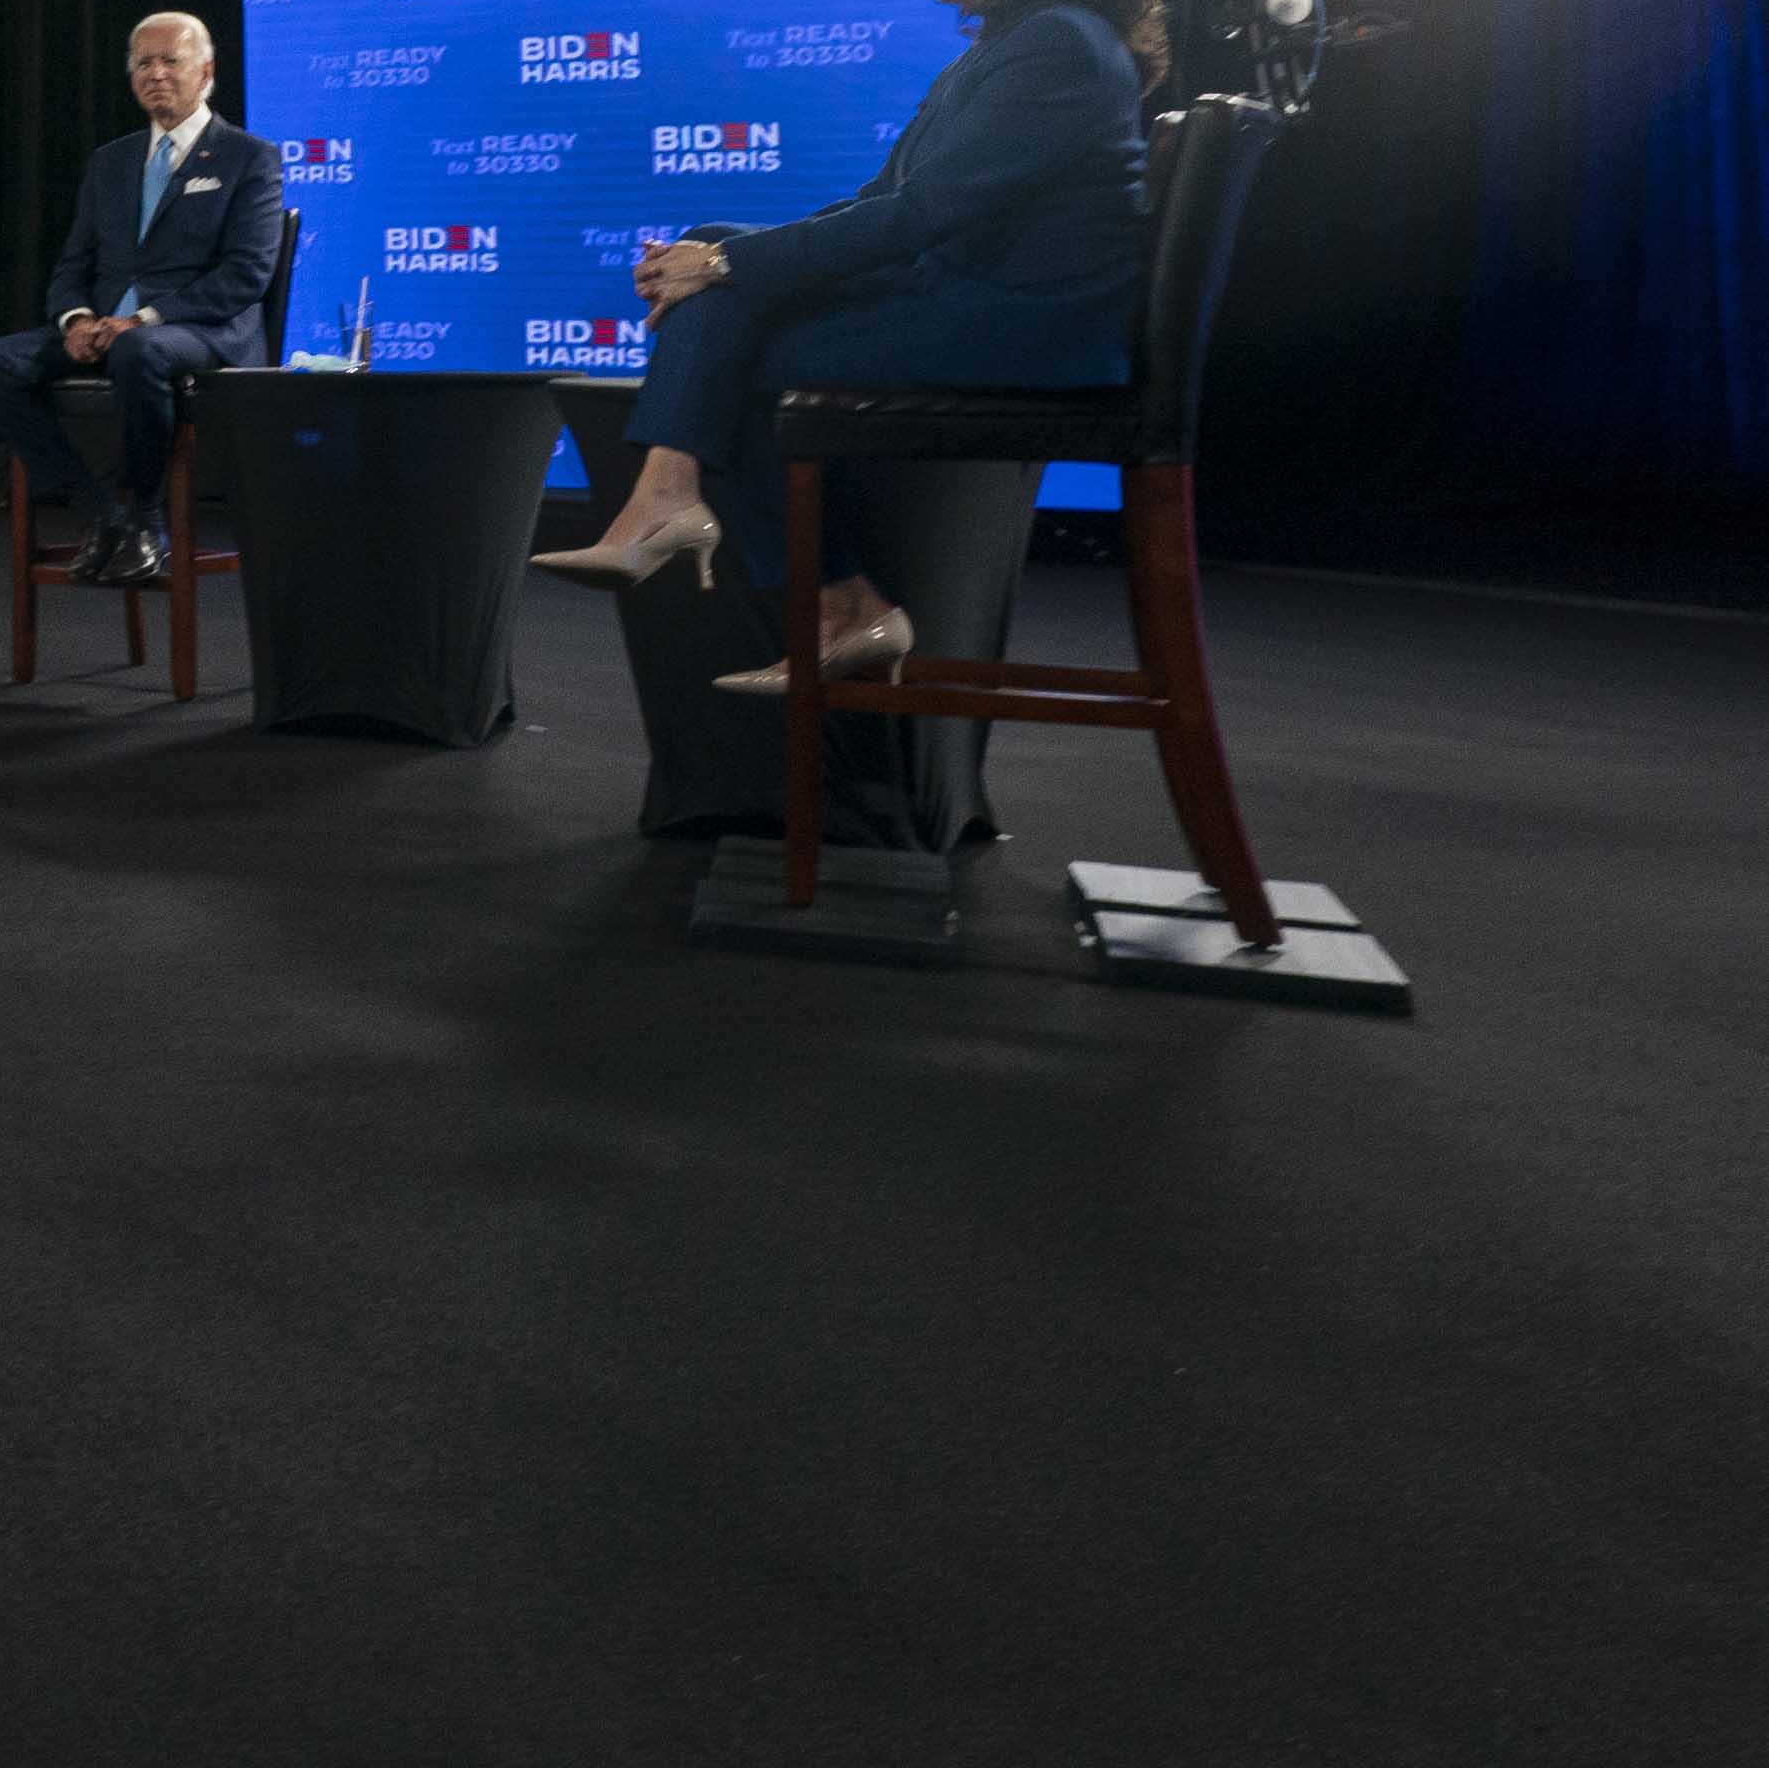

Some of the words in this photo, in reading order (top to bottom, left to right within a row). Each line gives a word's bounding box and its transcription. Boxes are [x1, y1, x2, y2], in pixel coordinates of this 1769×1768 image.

[783, 20, 895, 46] READY
[355, 45, 448, 67] READY
[520, 31, 640, 63] BIDEN
[776, 43, 874, 68] 30330
[348, 66, 431, 88] 30330
[520, 58, 642, 85] HARRIS
[481, 133, 578, 153] READY
[653, 121, 781, 153] BIDEN
[282, 138, 352, 163] DEN
[282, 164, 354, 184] RRIS
[474, 154, 561, 174] 30330
[653, 149, 783, 176] HARRIS
[385, 225, 498, 252] BIDEN
[384, 252, 499, 274] HARRIS
[378, 322, 452, 339] EADY
[525, 319, 647, 344] BIDEN
[372, 341, 436, 360] 0330
[525, 347, 649, 368] HARRIS
